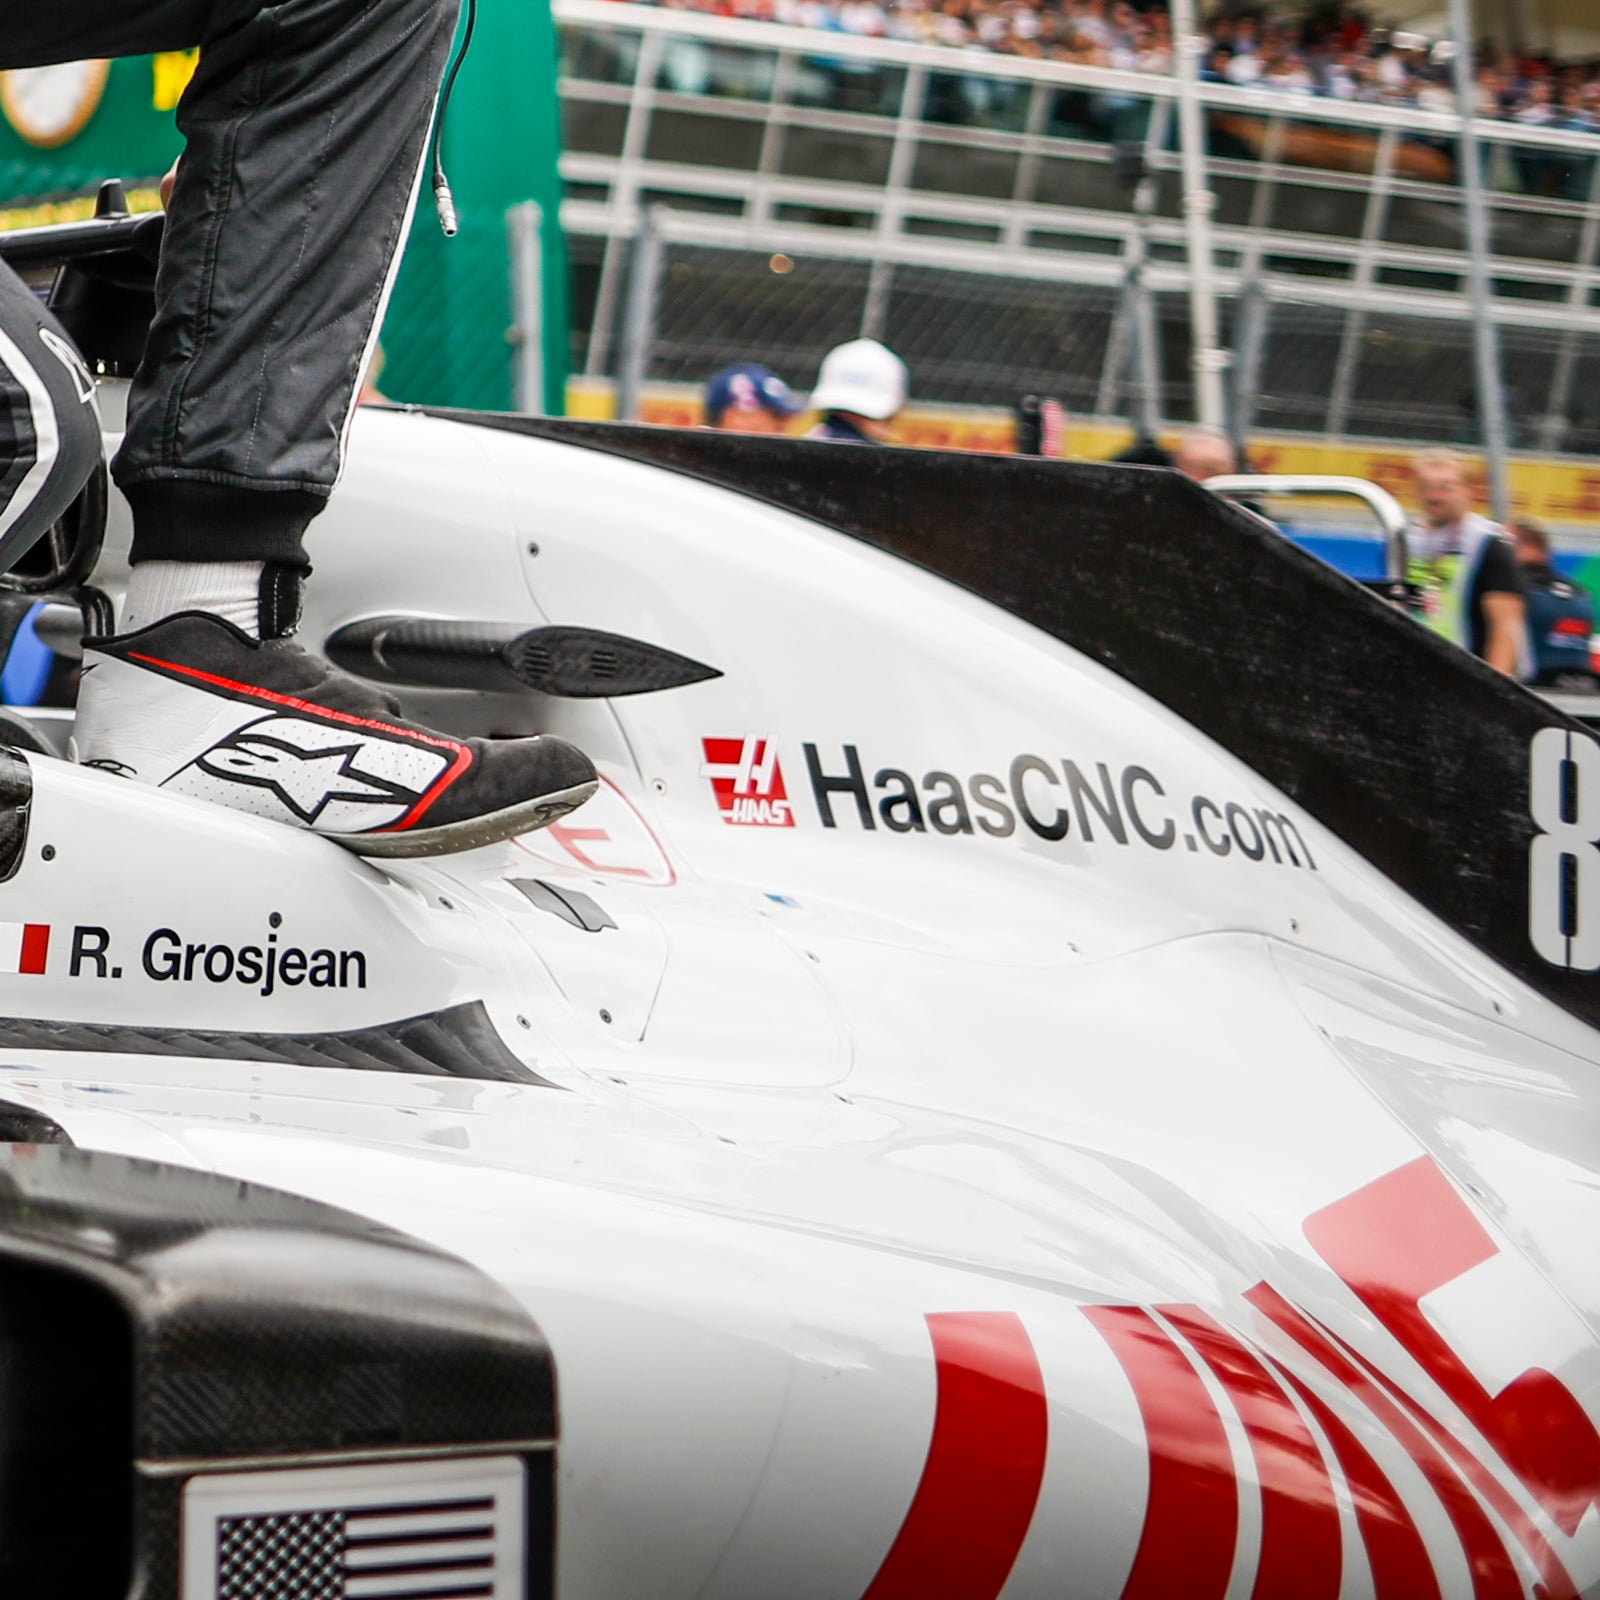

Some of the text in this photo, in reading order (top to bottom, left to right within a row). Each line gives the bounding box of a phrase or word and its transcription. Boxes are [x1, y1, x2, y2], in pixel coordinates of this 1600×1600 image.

[720, 798, 790, 825] HAAS
[802, 742, 1318, 871] HaasCNC.com
[69, 925, 367, 997] R. Grosjean
